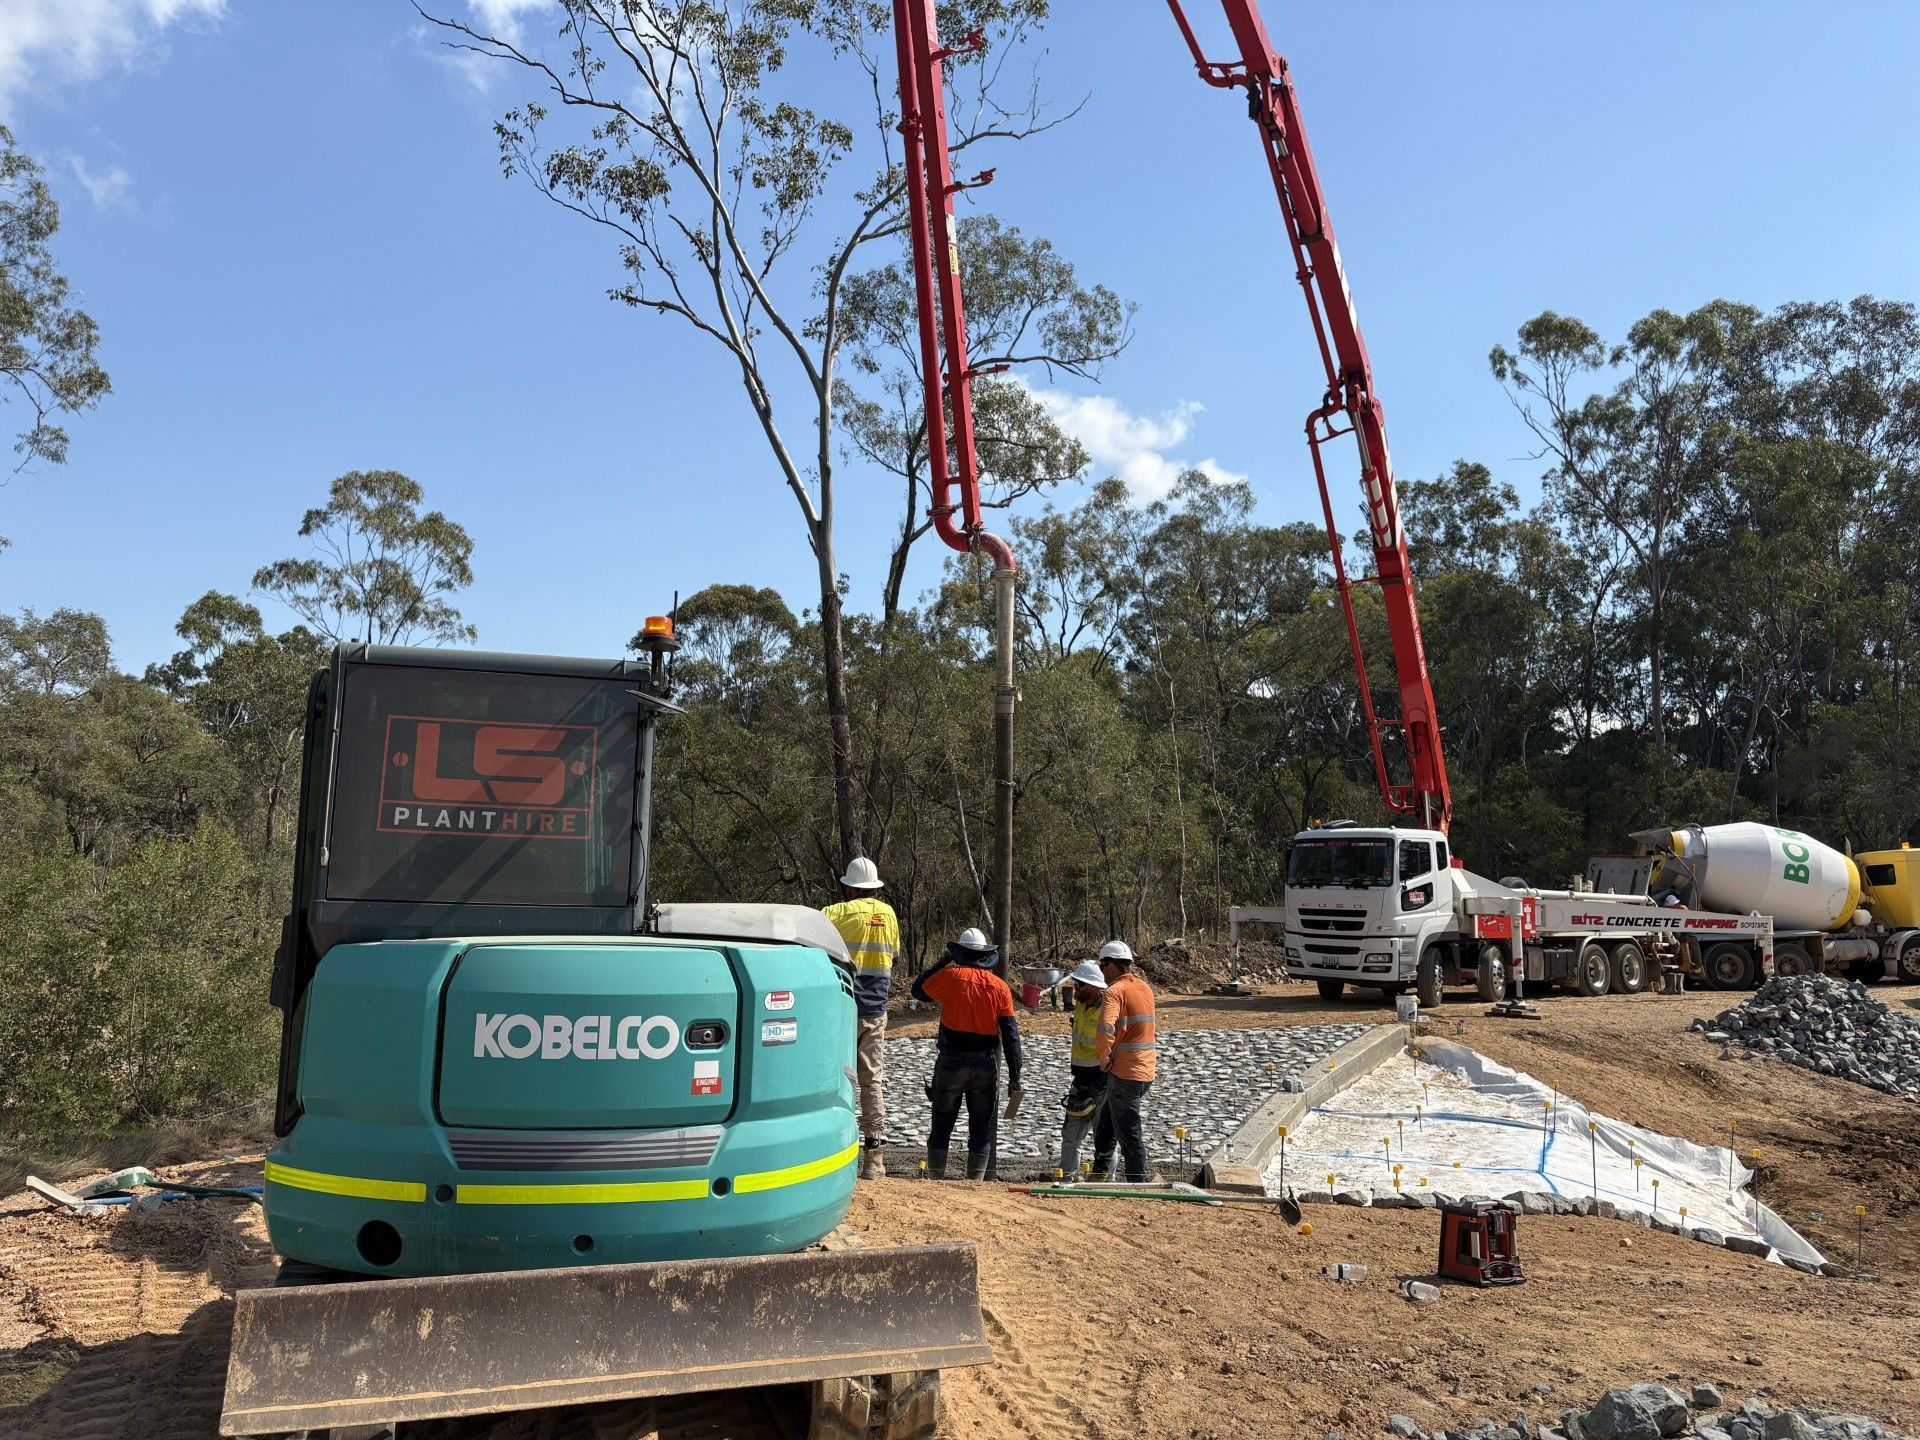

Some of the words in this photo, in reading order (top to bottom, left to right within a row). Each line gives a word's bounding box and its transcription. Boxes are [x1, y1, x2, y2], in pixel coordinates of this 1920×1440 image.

[413, 722, 566, 805] LS
[1606, 916, 1682, 928] CONCRETE
[1684, 918, 1739, 929] PUMPING
[474, 1013, 680, 1060] KOBELCO
